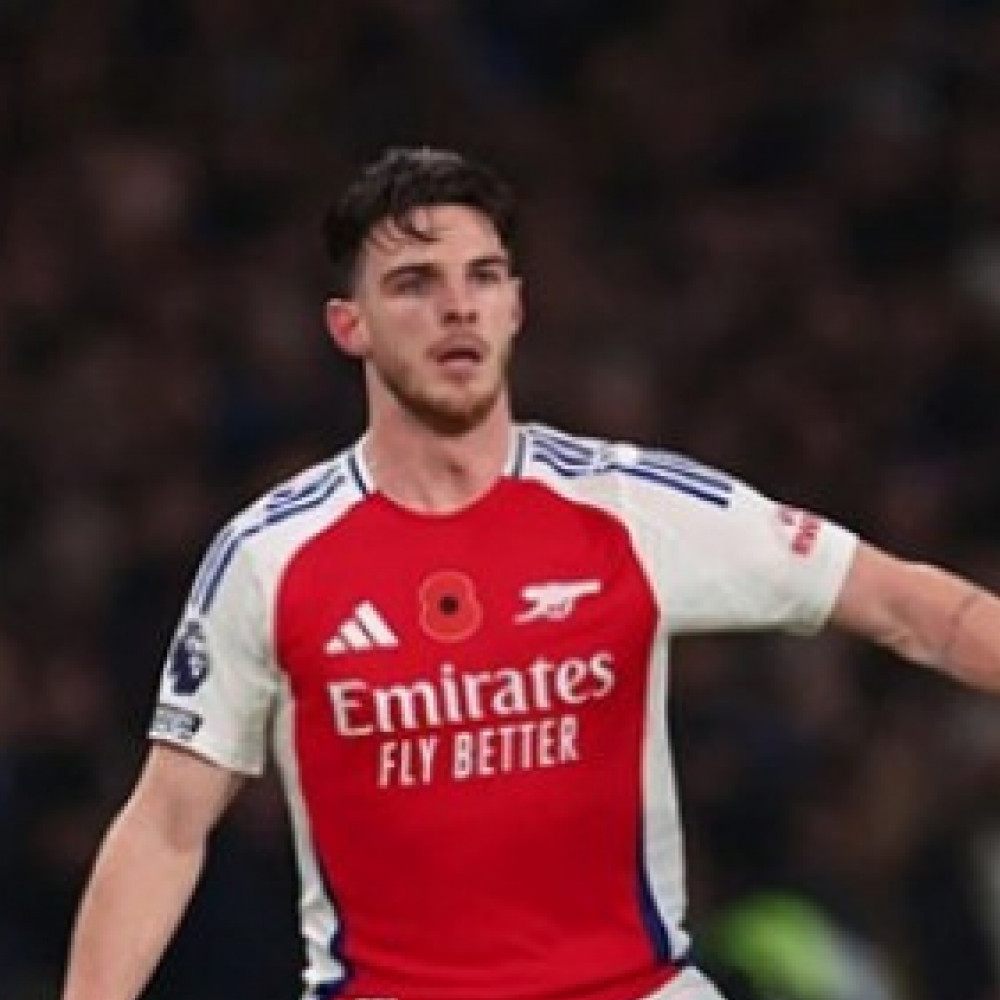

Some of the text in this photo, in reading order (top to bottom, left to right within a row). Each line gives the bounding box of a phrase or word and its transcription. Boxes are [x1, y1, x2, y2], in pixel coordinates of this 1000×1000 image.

[327, 650, 616, 737] Emirates
[376, 713, 581, 789] FLY BETTER
